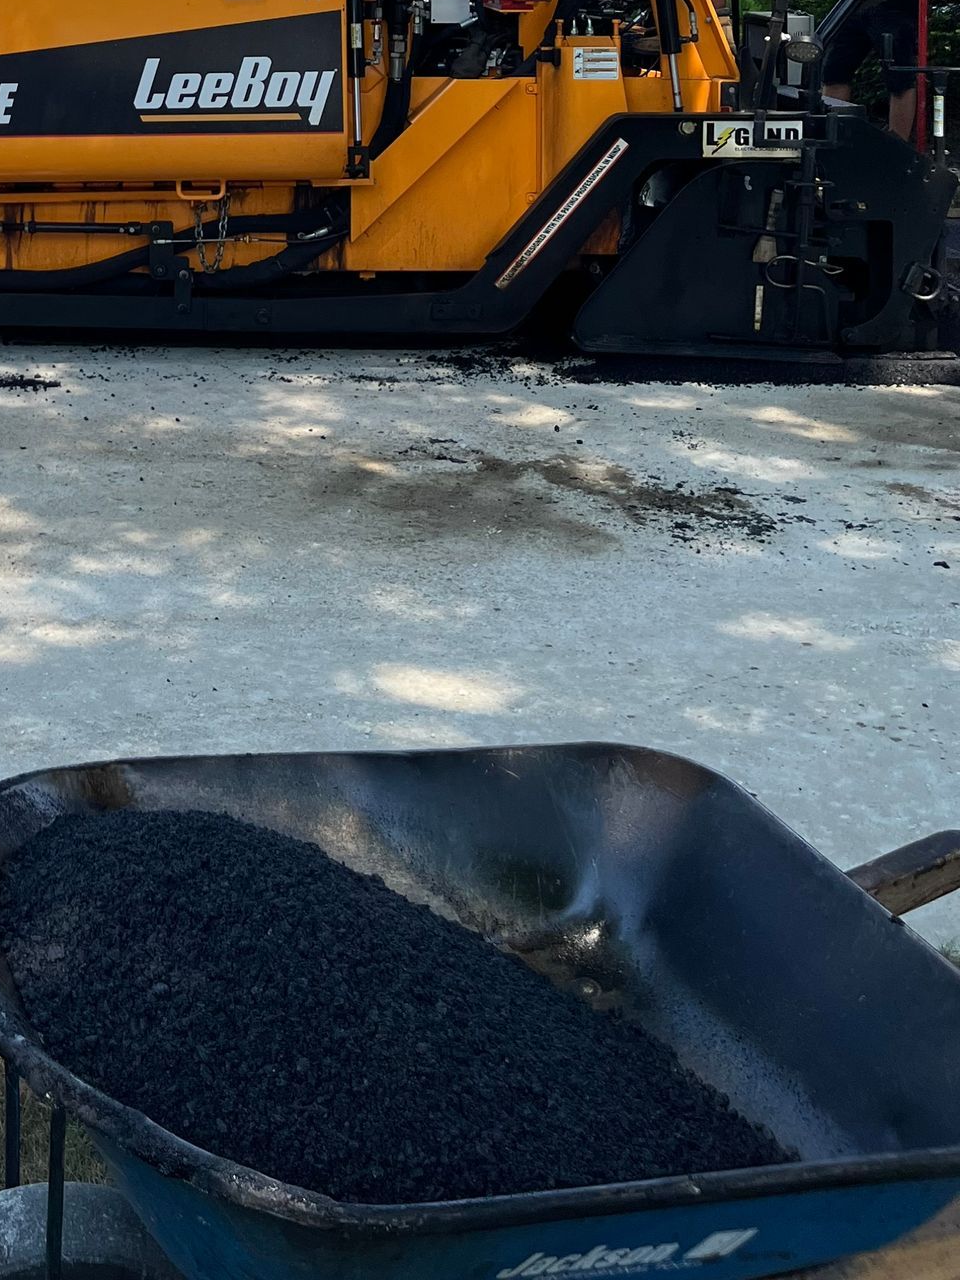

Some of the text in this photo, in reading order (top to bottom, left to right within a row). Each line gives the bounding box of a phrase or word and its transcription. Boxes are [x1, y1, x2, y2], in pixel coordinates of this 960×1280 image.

[133, 56, 336, 126] LeeBoy
[706, 122, 799, 146] LGND
[543, 221, 556, 234] WITH
[553, 212, 565, 222] THE
[561, 196, 578, 213] PAVING
[575, 163, 606, 197] PROFESSIONAL
[496, 1244, 680, 1280] Jackson
